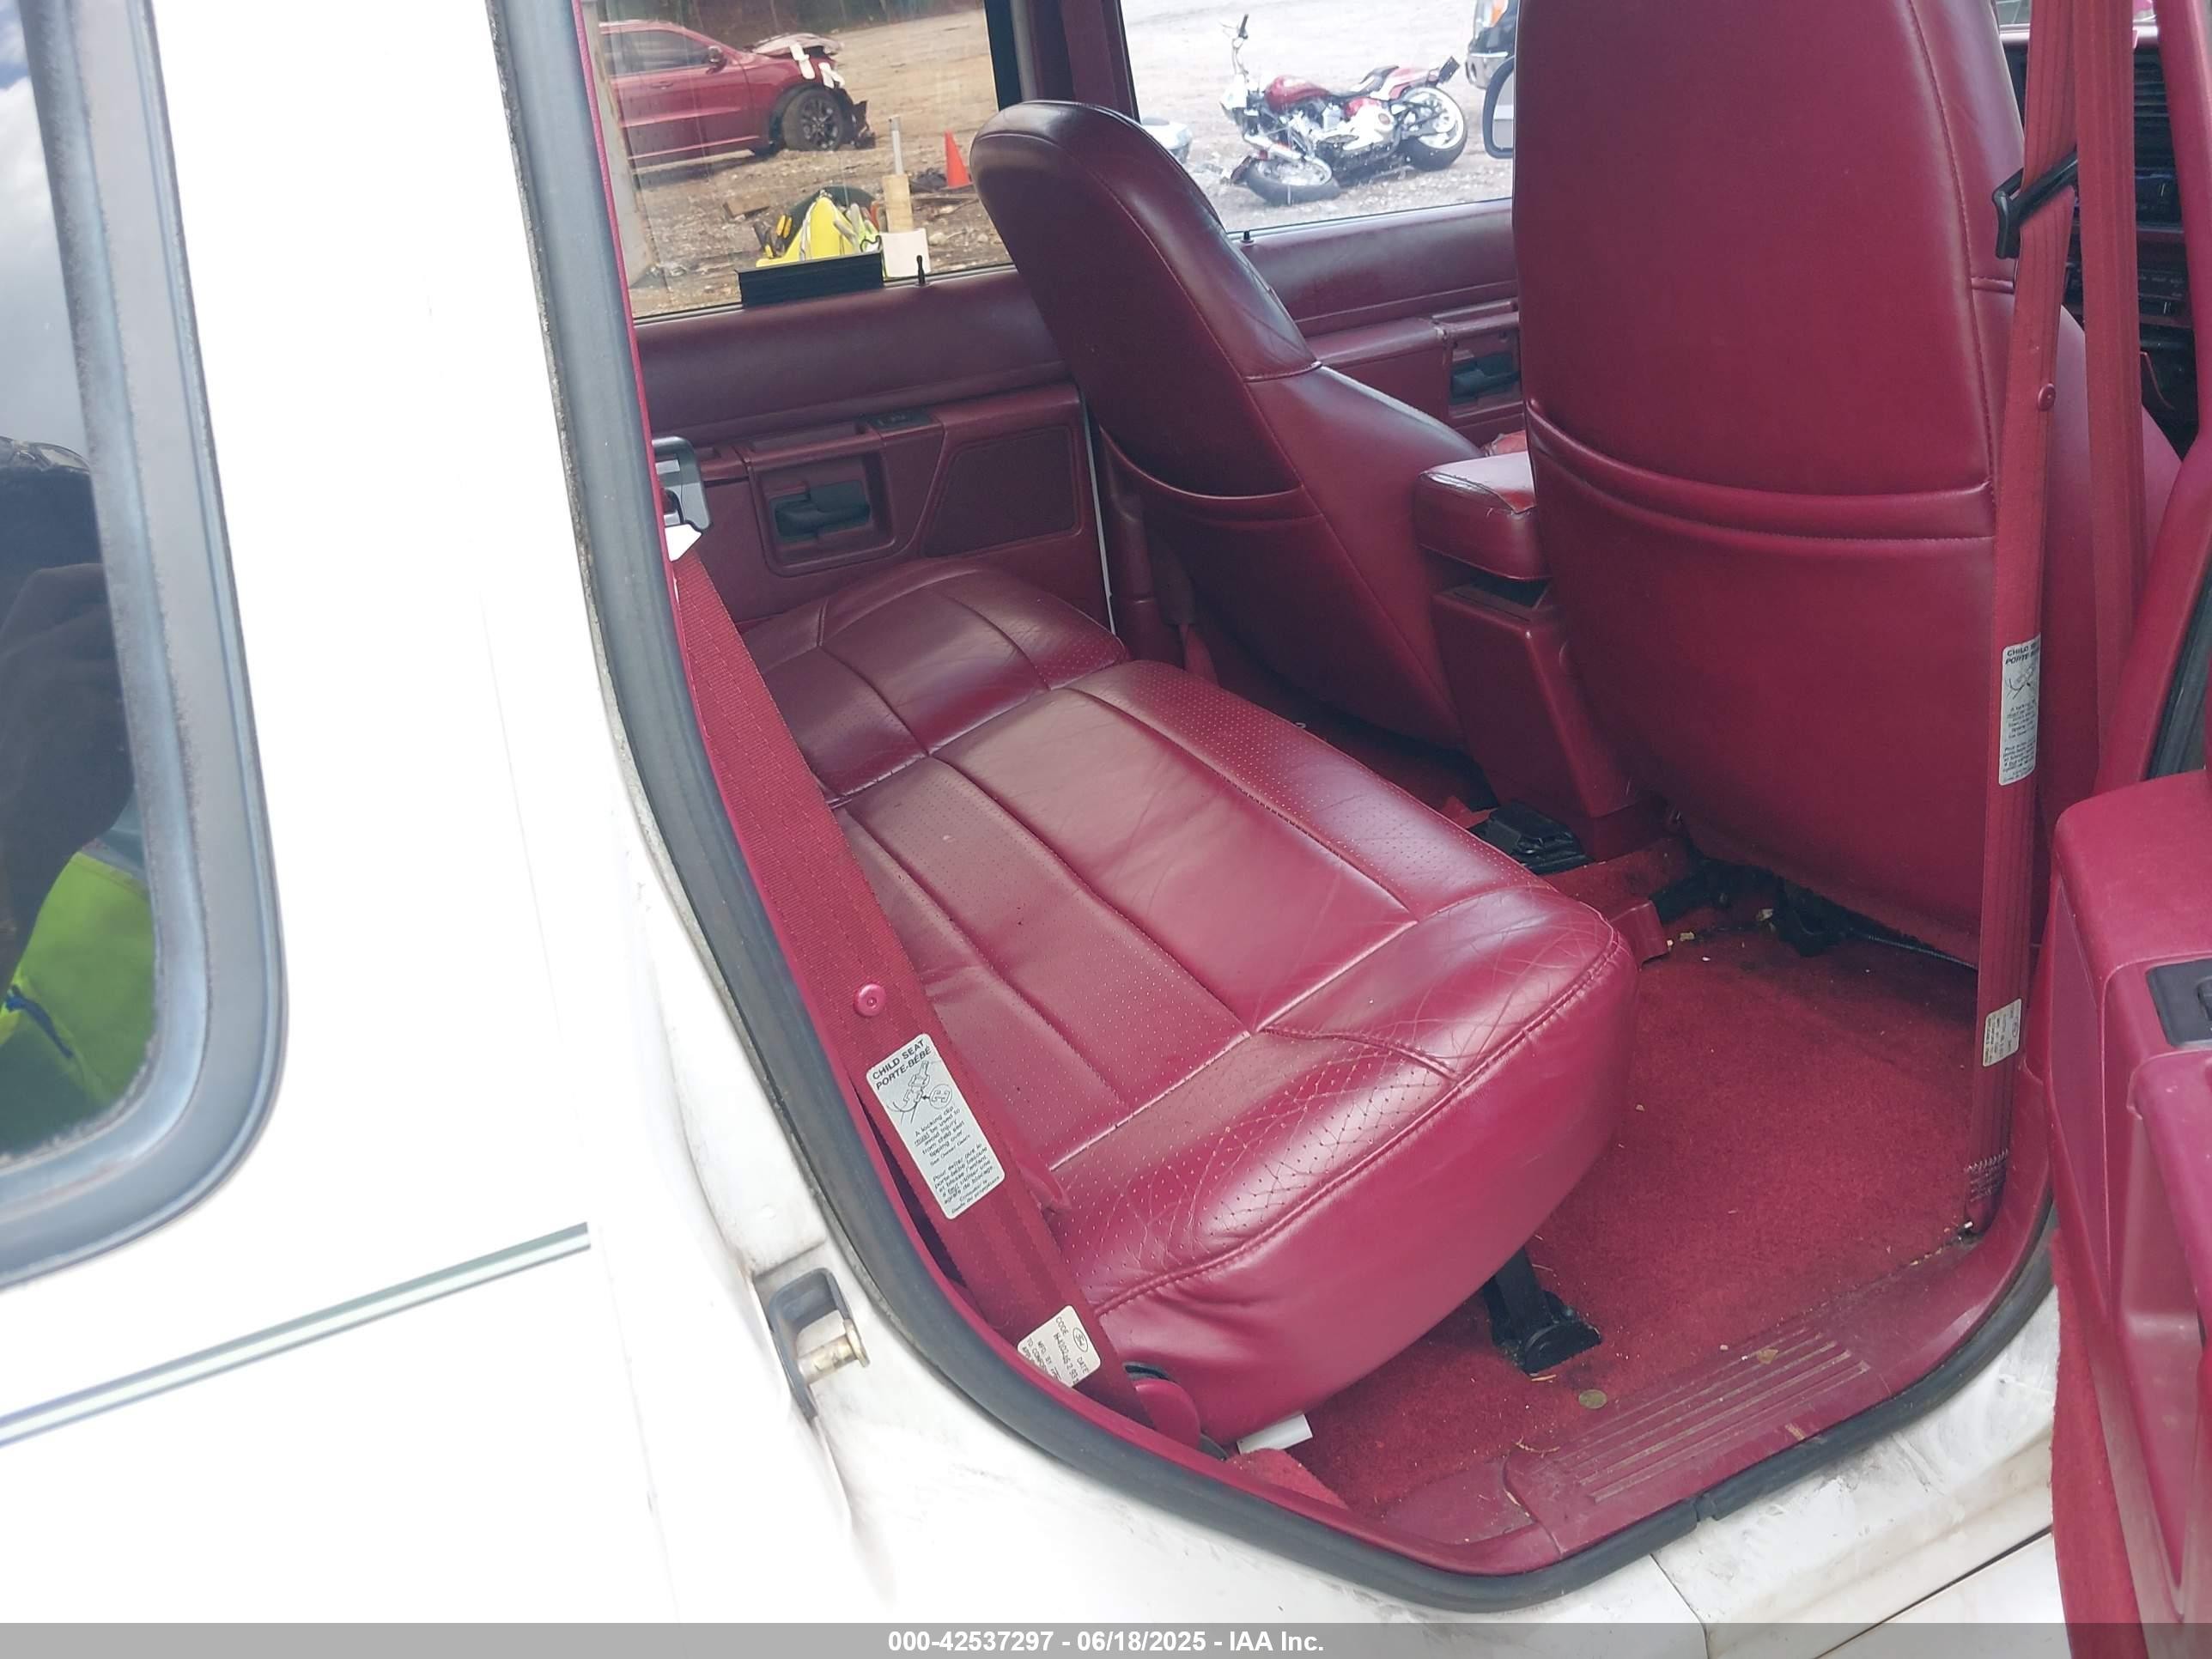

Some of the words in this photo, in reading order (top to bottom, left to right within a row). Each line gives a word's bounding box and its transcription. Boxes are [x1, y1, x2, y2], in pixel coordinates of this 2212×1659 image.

[2007, 646, 2029, 657] CHILD
[872, 1057, 900, 1079] CHILD
[902, 1038, 923, 1060] SEAT
[876, 1045, 931, 1091] PORTE-BÉBÉ
[1055, 1316, 1069, 1336] CODE
[1077, 1357, 1090, 1374] DATE
